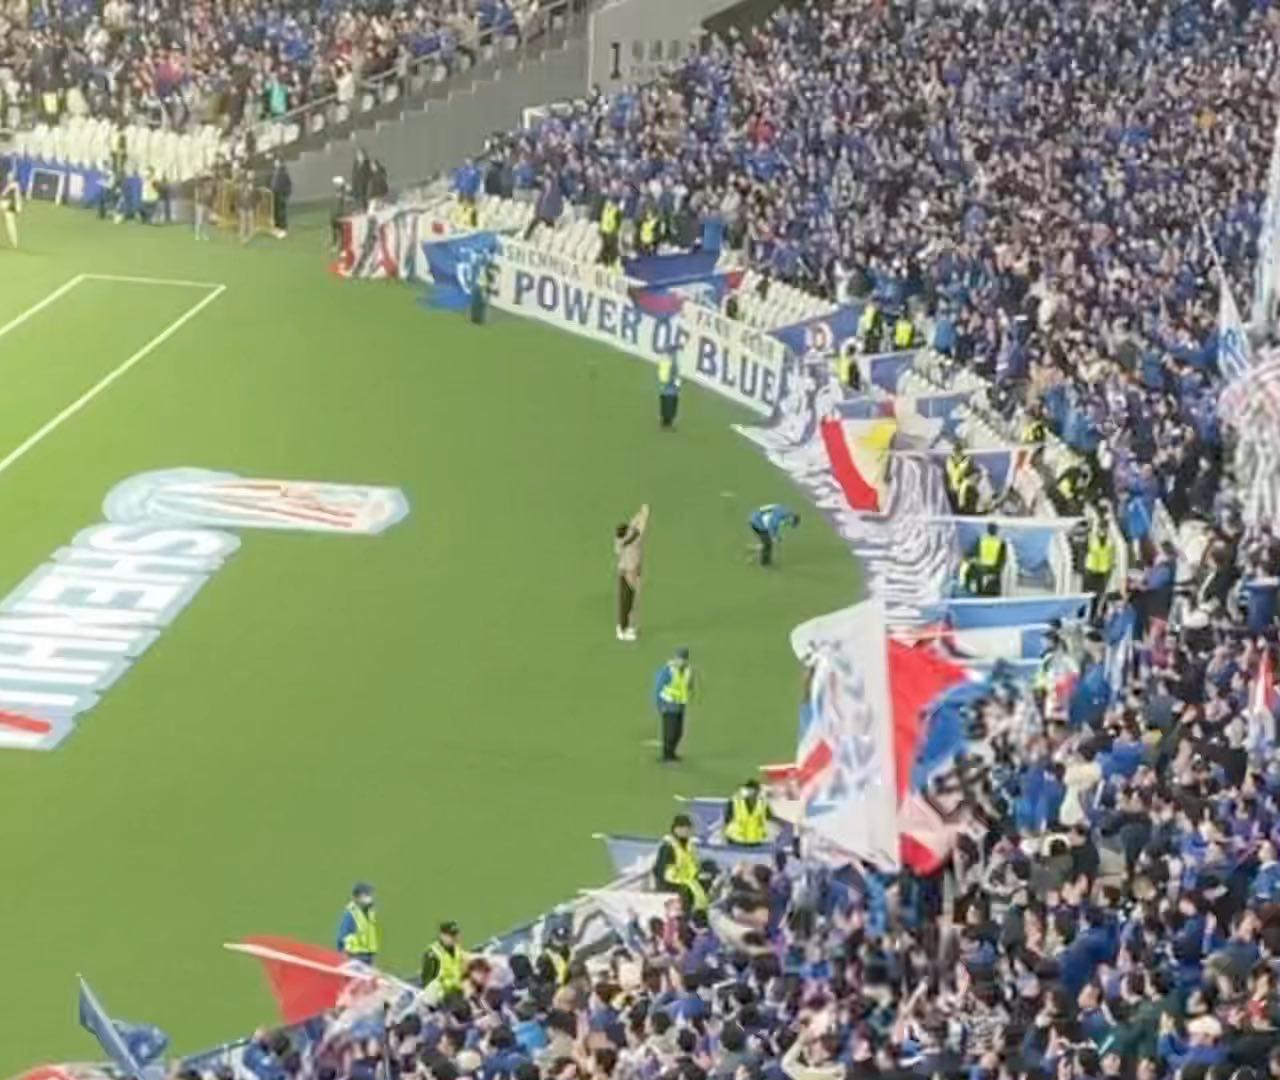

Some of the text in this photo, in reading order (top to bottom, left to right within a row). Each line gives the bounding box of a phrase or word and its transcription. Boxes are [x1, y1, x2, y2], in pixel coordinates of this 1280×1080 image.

[512, 270, 642, 345] POWER
[652, 314, 690, 355] OF
[696, 335, 776, 407] BLUE
